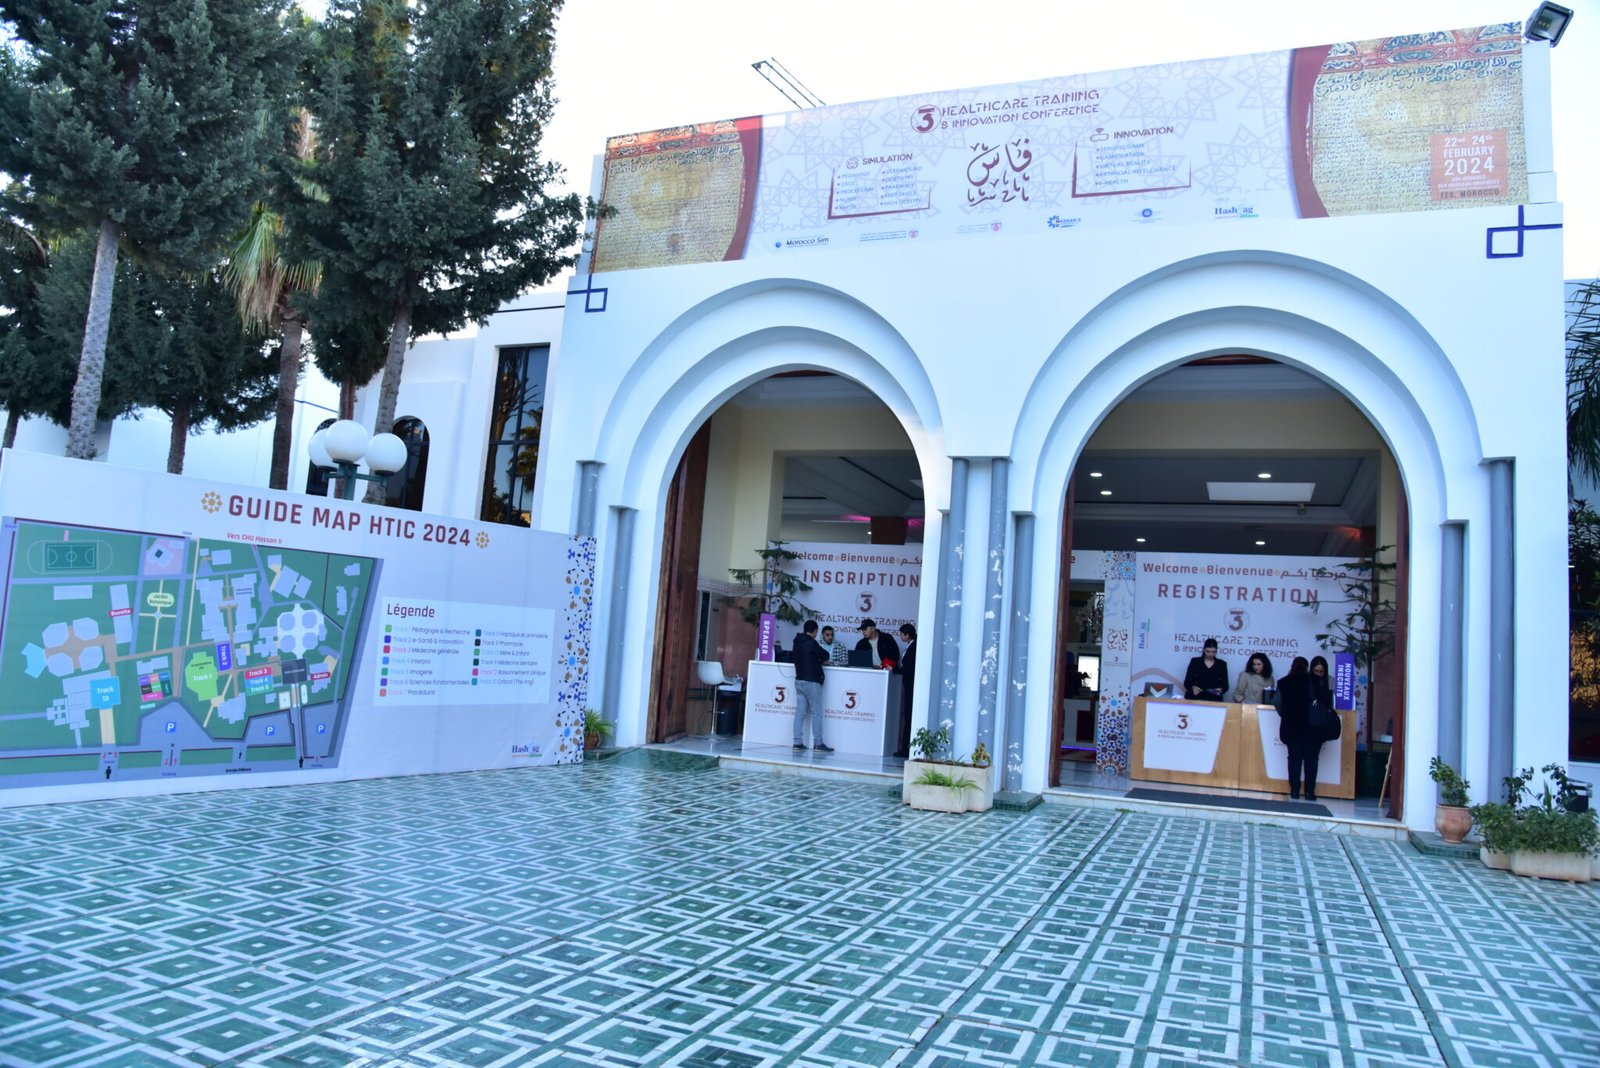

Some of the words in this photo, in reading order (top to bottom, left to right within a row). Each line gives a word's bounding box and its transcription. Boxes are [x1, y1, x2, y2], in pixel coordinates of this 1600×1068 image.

[942, 98, 1028, 116] HEALTHCARE
[1034, 90, 1100, 106] TRAINING
[941, 122, 948, 130] &
[952, 112, 1018, 128] INNOVATION
[1022, 104, 1099, 120] CONFERENCE
[1114, 126, 1174, 139] INNOVATION
[862, 153, 913, 165] SIMULATION
[1444, 146, 1494, 158] FEBRUARY
[1444, 156, 1494, 176] 2024
[1460, 188, 1499, 197] MOROCCO
[228, 495, 303, 524] GUIDE
[312, 506, 361, 531] MAP
[369, 516, 416, 539] HTIC
[422, 523, 471, 546] 2024
[241, 533, 254, 541] CHU
[256, 536, 277, 544] Hassan
[840, 553, 895, 564] Bienvenue
[1143, 563, 1198, 574] Welcome
[1207, 565, 1274, 576] Bienvenue
[1280, 569, 1308, 580] بكم
[804, 570, 920, 587] INSCRIPTION
[1158, 583, 1318, 603] REGISTRATION
[387, 603, 435, 618] Légende
[860, 594, 872, 612] 3
[875, 617, 916, 627] TRAINING
[1228, 611, 1244, 631] 3
[761, 620, 770, 655] SPEAKER
[1248, 637, 1299, 648] TRAINING
[775, 687, 785, 703] 3
[845, 692, 856, 709] 3
[168, 723, 174, 731] P
[1178, 714, 1188, 730] 3
